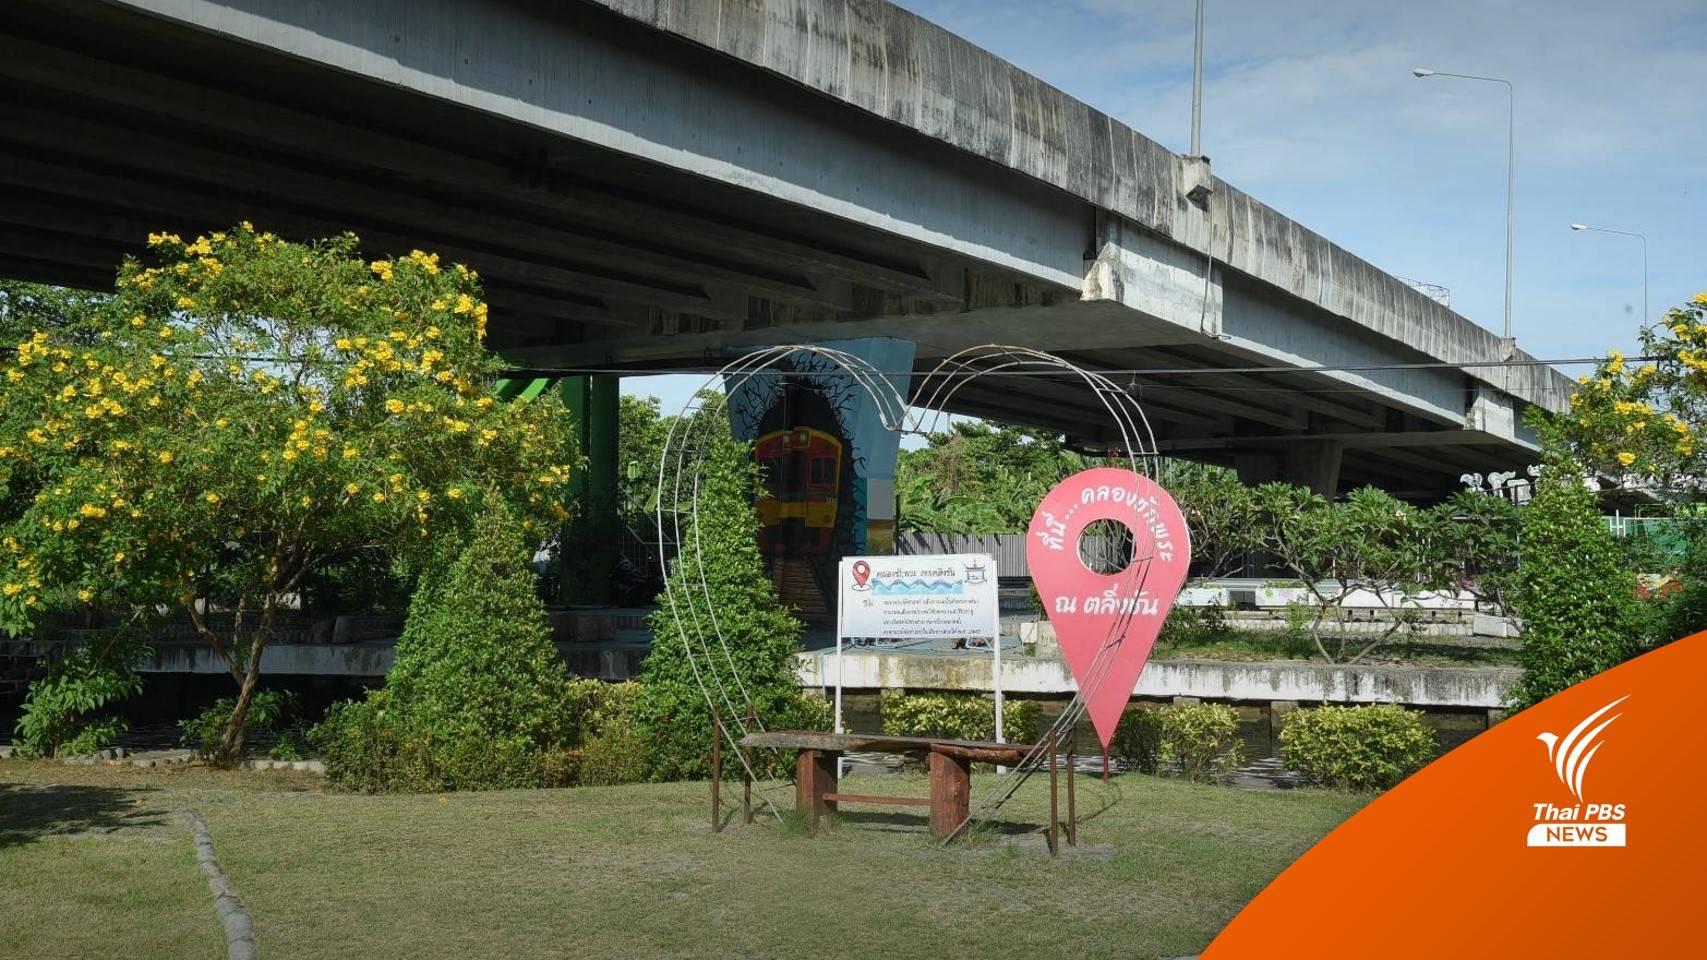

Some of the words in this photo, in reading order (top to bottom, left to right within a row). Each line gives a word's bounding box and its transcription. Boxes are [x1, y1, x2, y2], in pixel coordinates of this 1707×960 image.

[1055, 596, 1077, 614] ณ
[1083, 583, 1160, 616] ตลิ่งชัน
